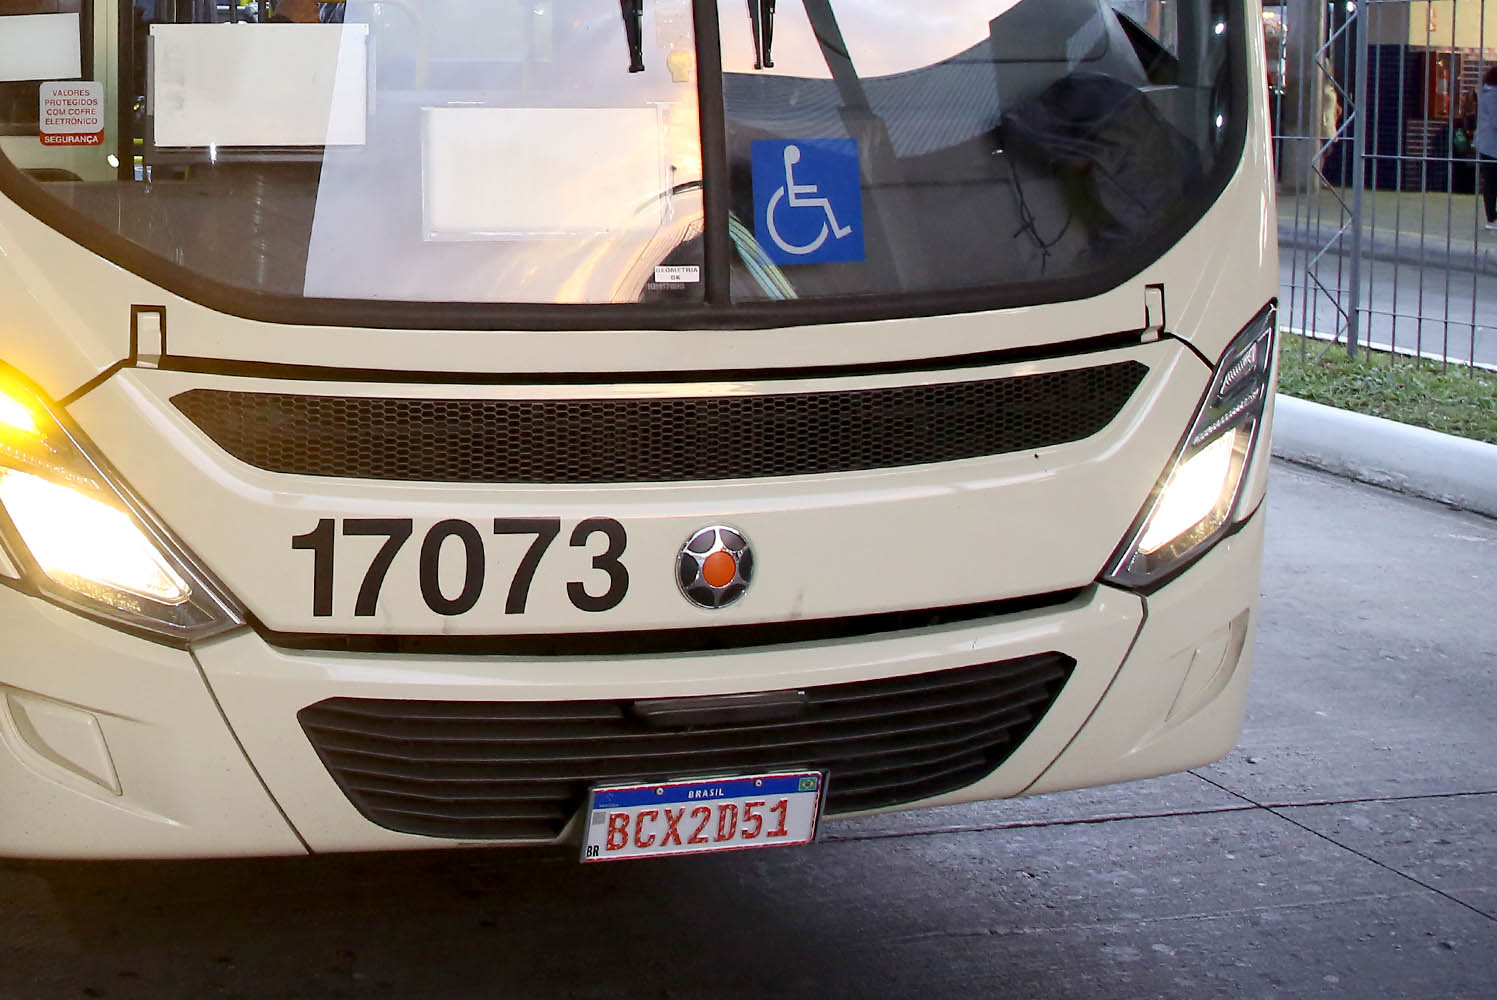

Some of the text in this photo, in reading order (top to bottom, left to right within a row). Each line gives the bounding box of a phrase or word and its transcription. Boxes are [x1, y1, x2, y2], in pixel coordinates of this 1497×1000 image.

[44, 98, 98, 106] PROTEGIDOS
[46, 108, 66, 116] COM
[44, 135, 99, 144] SEGURANÇA
[292, 515, 630, 617] 17073
[688, 788, 725, 799] BRASIL
[605, 798, 789, 852] BCX2D51
[586, 844, 600, 857] BR
